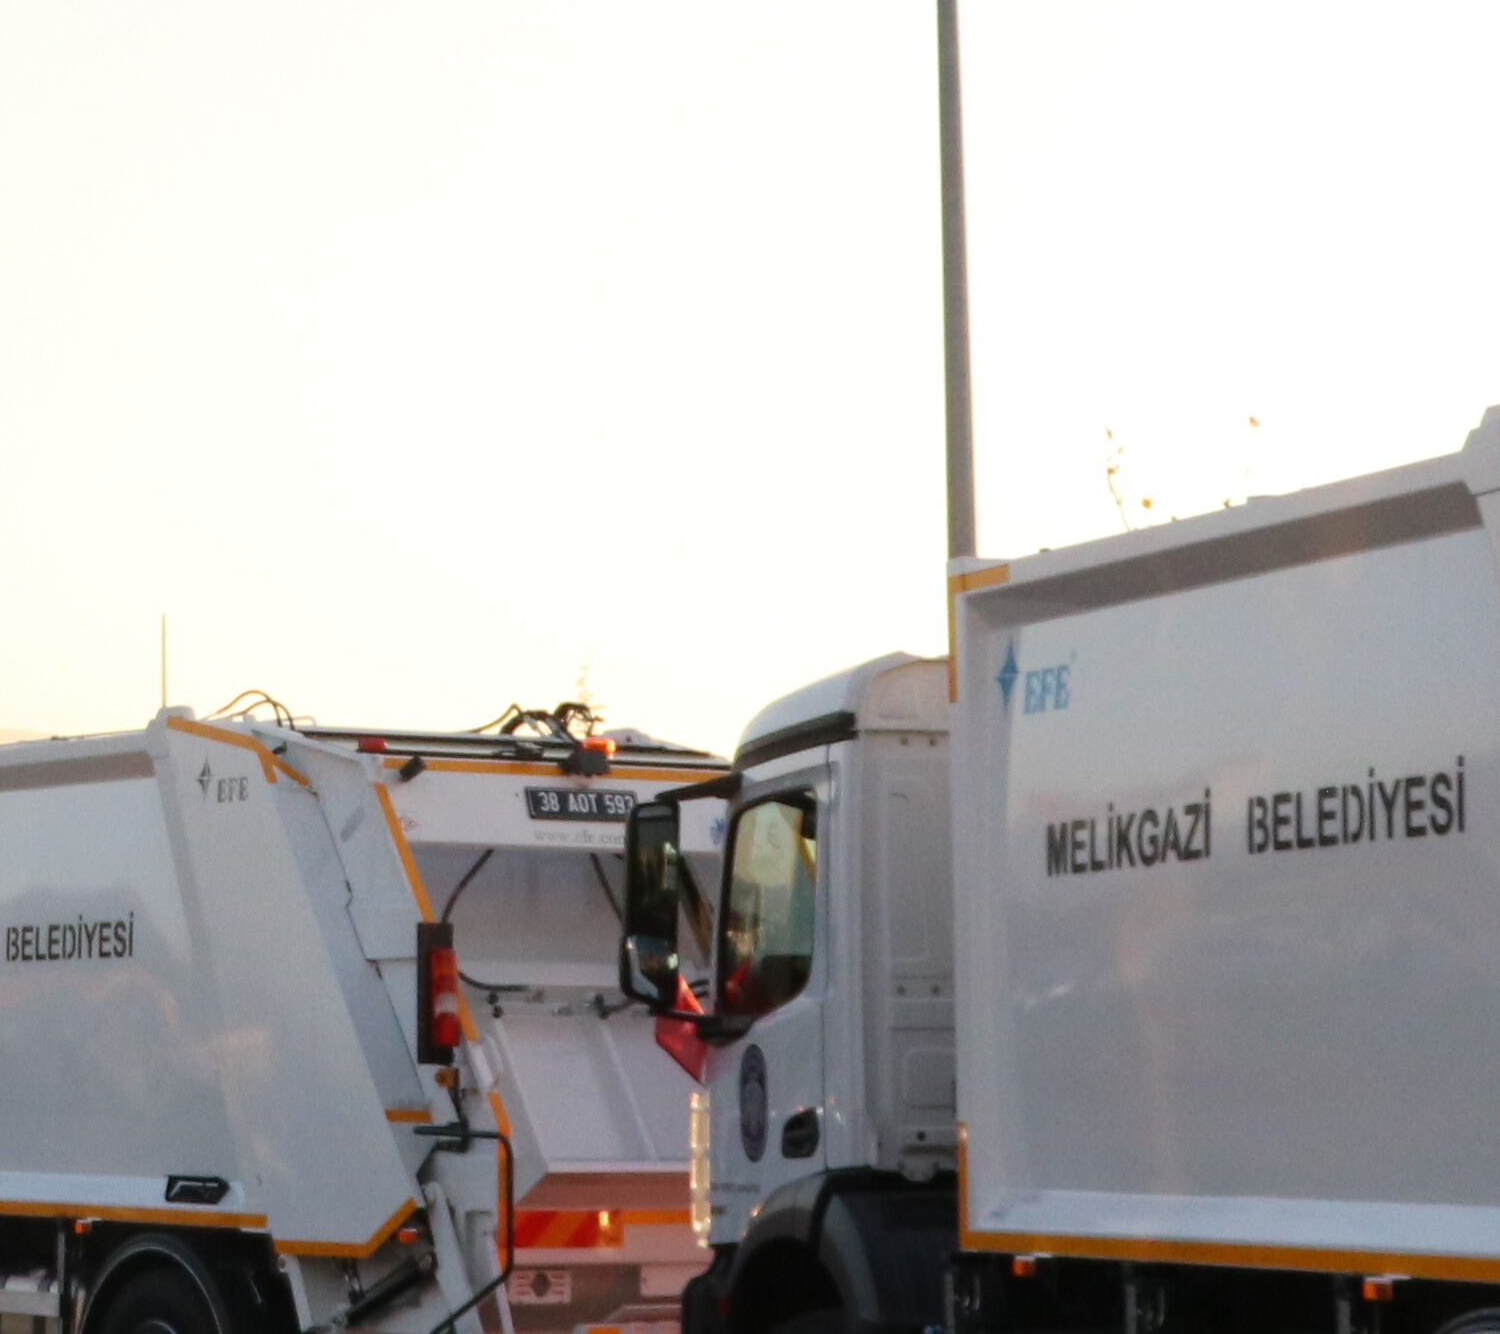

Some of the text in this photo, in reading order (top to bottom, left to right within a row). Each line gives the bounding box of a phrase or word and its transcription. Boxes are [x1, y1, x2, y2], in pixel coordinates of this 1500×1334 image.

[1023, 664, 1070, 715] EFE
[216, 776, 248, 803] EFE
[538, 791, 559, 812] 38
[569, 792, 598, 813] AOT
[1046, 755, 1466, 877] MELİKGAZİ BELEDİYESİ
[6, 911, 134, 962] BELEDİYESİ
